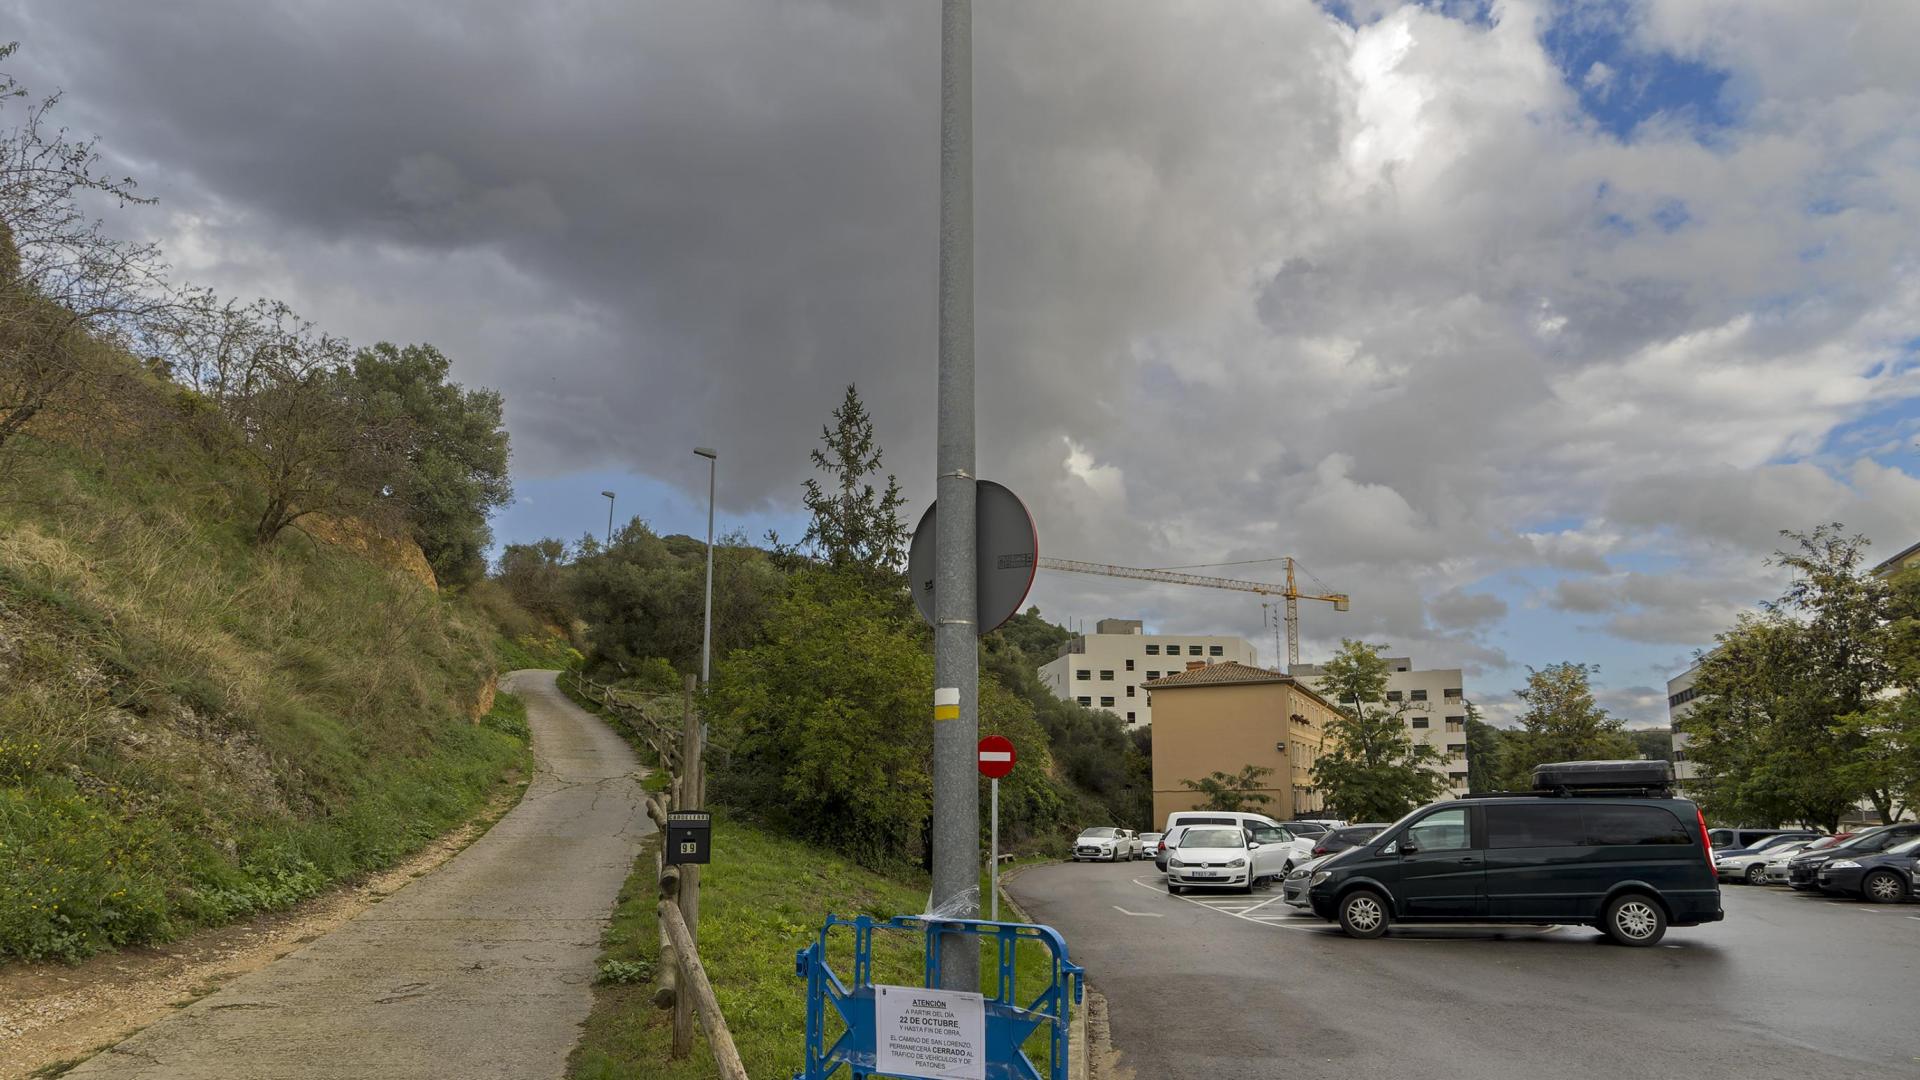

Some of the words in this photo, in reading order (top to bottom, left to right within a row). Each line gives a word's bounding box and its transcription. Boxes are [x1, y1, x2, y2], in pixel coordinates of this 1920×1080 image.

[682, 843, 695, 852] 99
[912, 999, 946, 1008] ATENCIÓN
[932, 1048, 966, 1056] CERRADO
[916, 1060, 946, 1070] PEATONES
